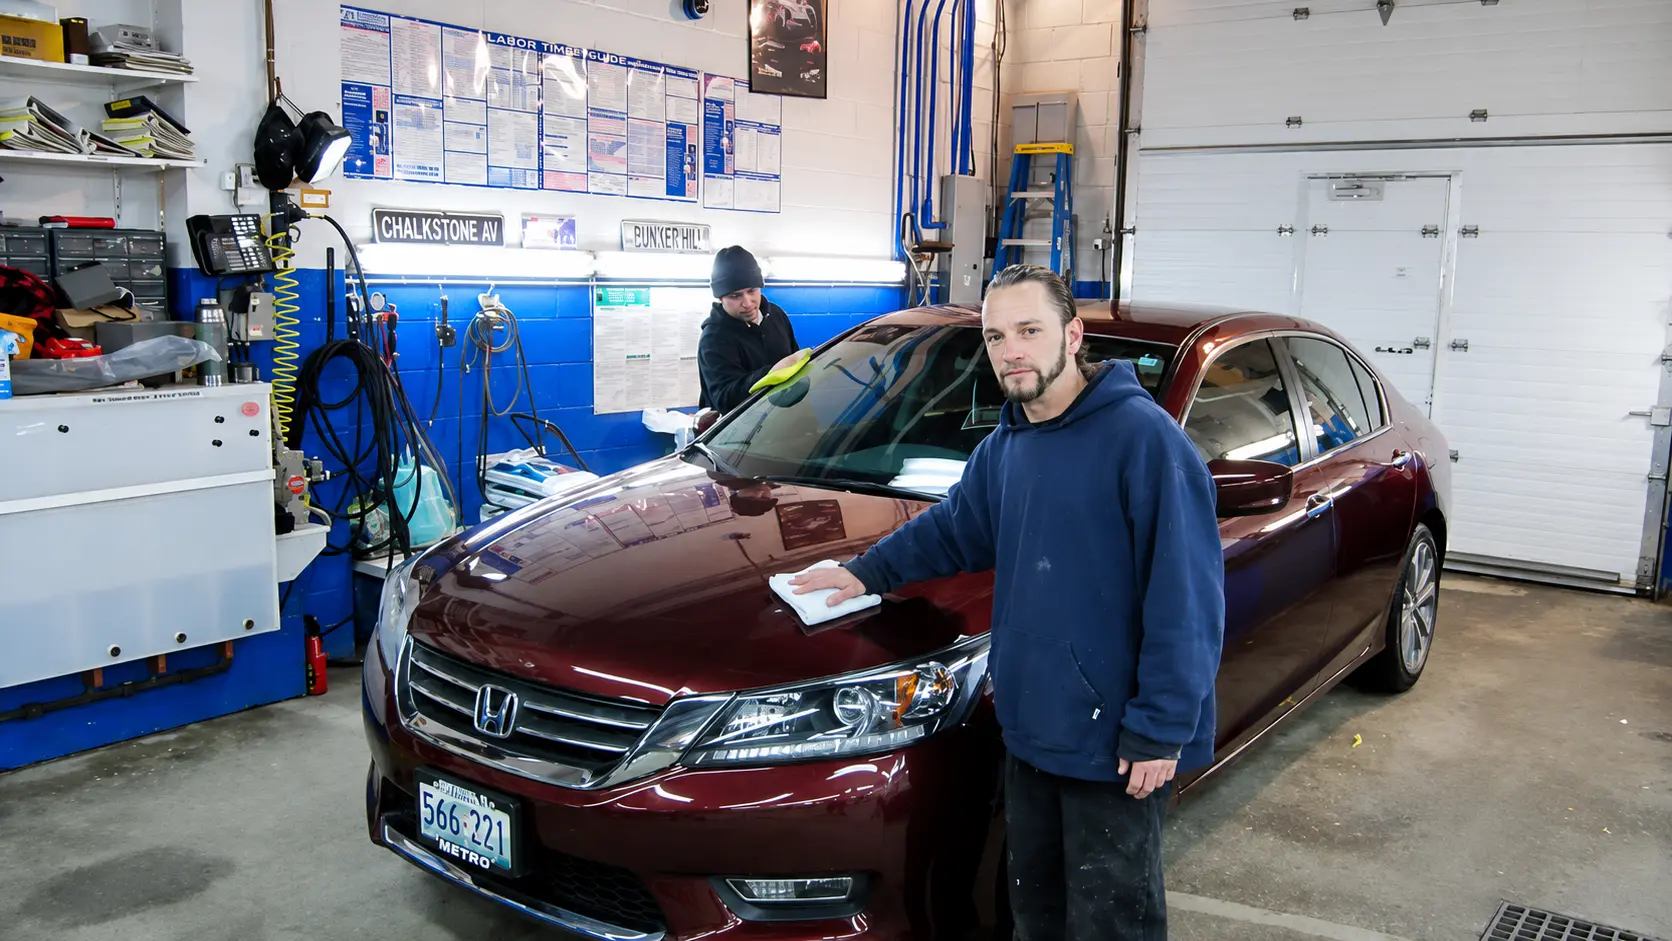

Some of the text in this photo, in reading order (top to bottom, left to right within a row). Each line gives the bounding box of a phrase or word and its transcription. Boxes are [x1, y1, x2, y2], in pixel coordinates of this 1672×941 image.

[487, 33, 536, 49] LABOR
[381, 215, 498, 242] CHALKSTONE AV
[634, 225, 702, 250] BUNKER HILL
[423, 791, 460, 836] 566
[469, 809, 504, 856] 221
[439, 839, 490, 869] METRO
